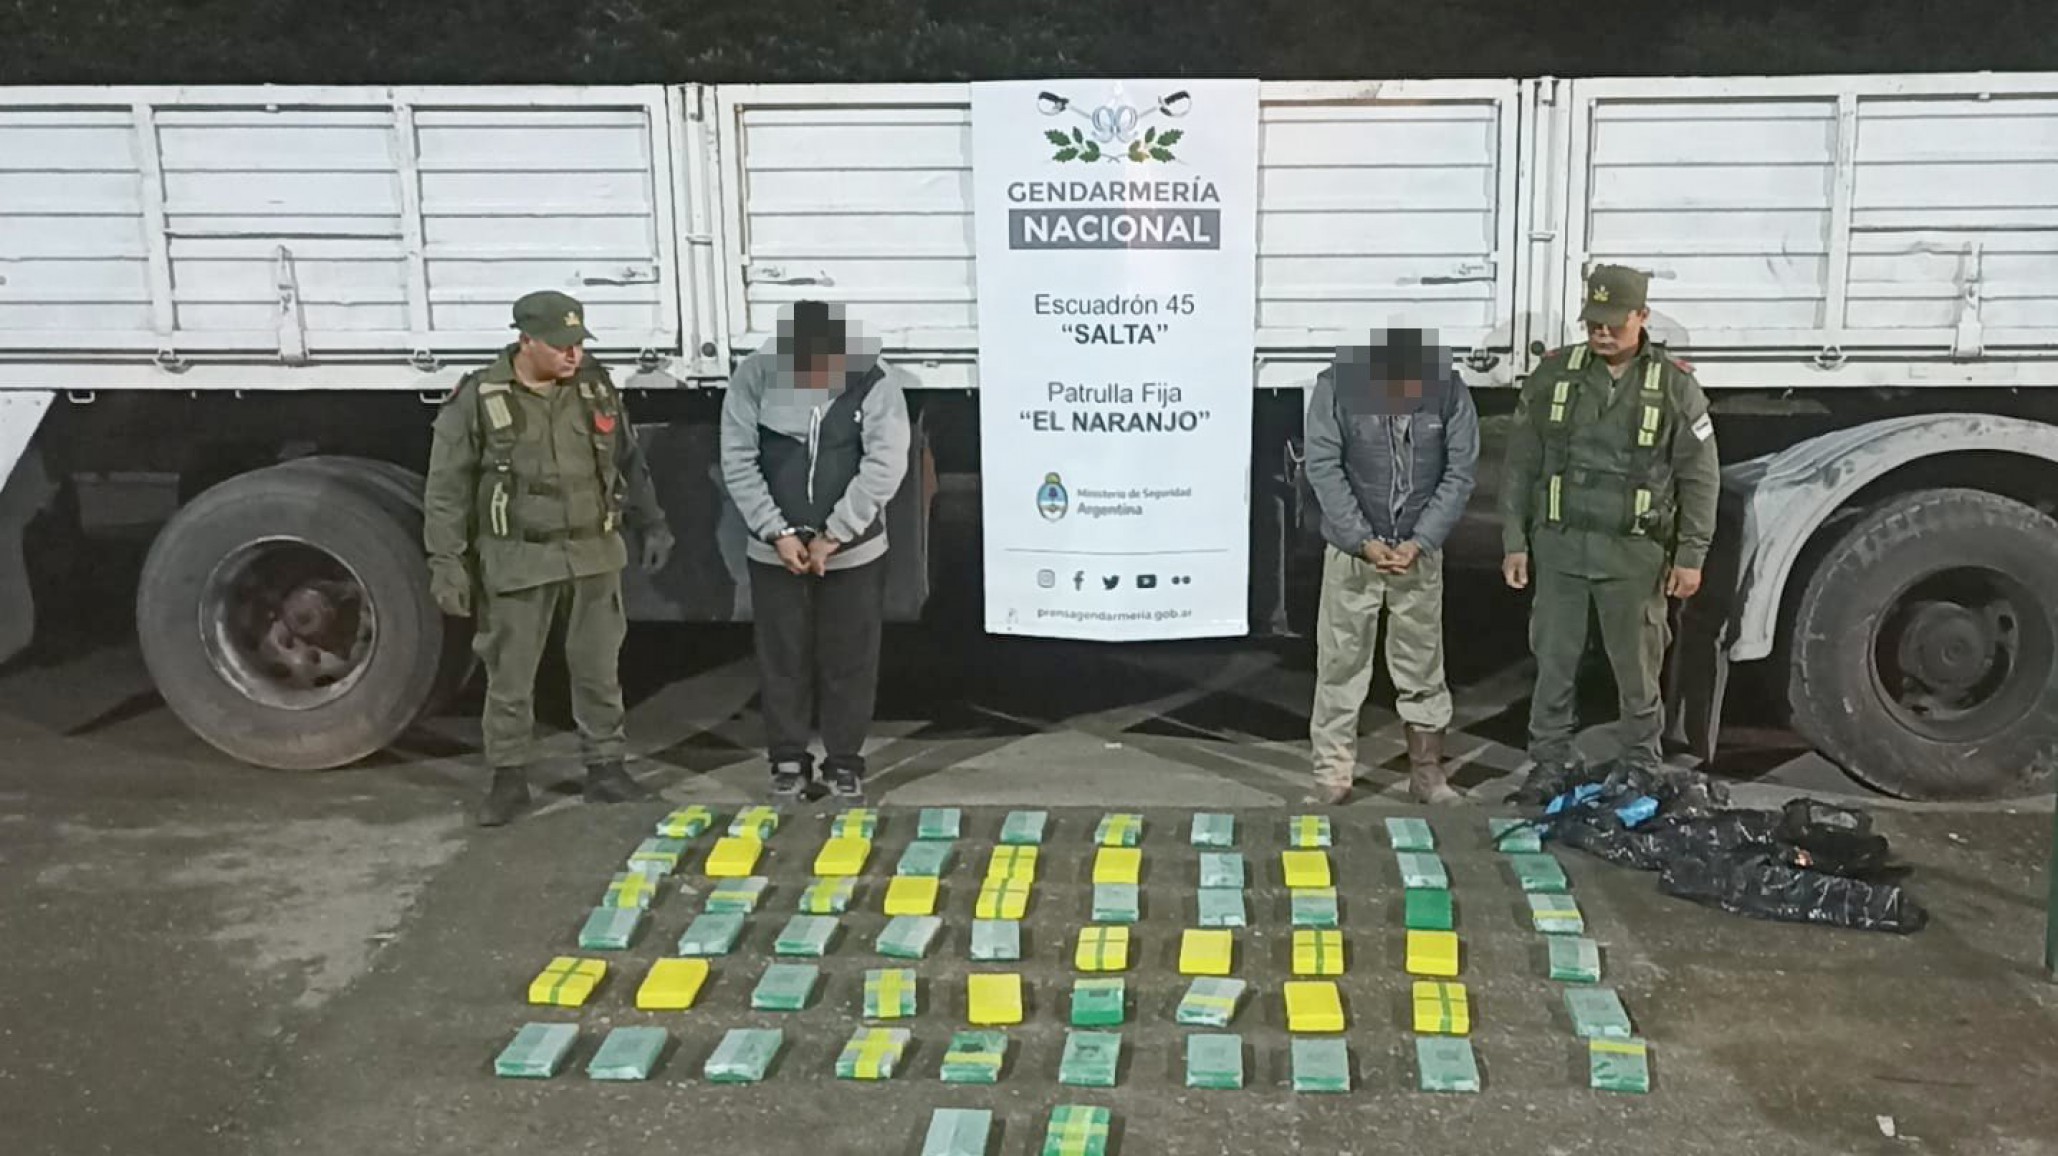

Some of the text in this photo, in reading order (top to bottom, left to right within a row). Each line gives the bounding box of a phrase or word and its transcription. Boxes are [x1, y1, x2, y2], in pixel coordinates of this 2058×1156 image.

[1008, 175, 1221, 203] GENDARMERÍA
[1022, 214, 1212, 244] NACIONAL
[1035, 292, 1195, 316] Escuadrón 45
[1048, 380, 1183, 408] Patrulla Fija
[1077, 487, 1192, 500] Ministerio de Seguridad
[1077, 501, 1144, 518] Argentina
